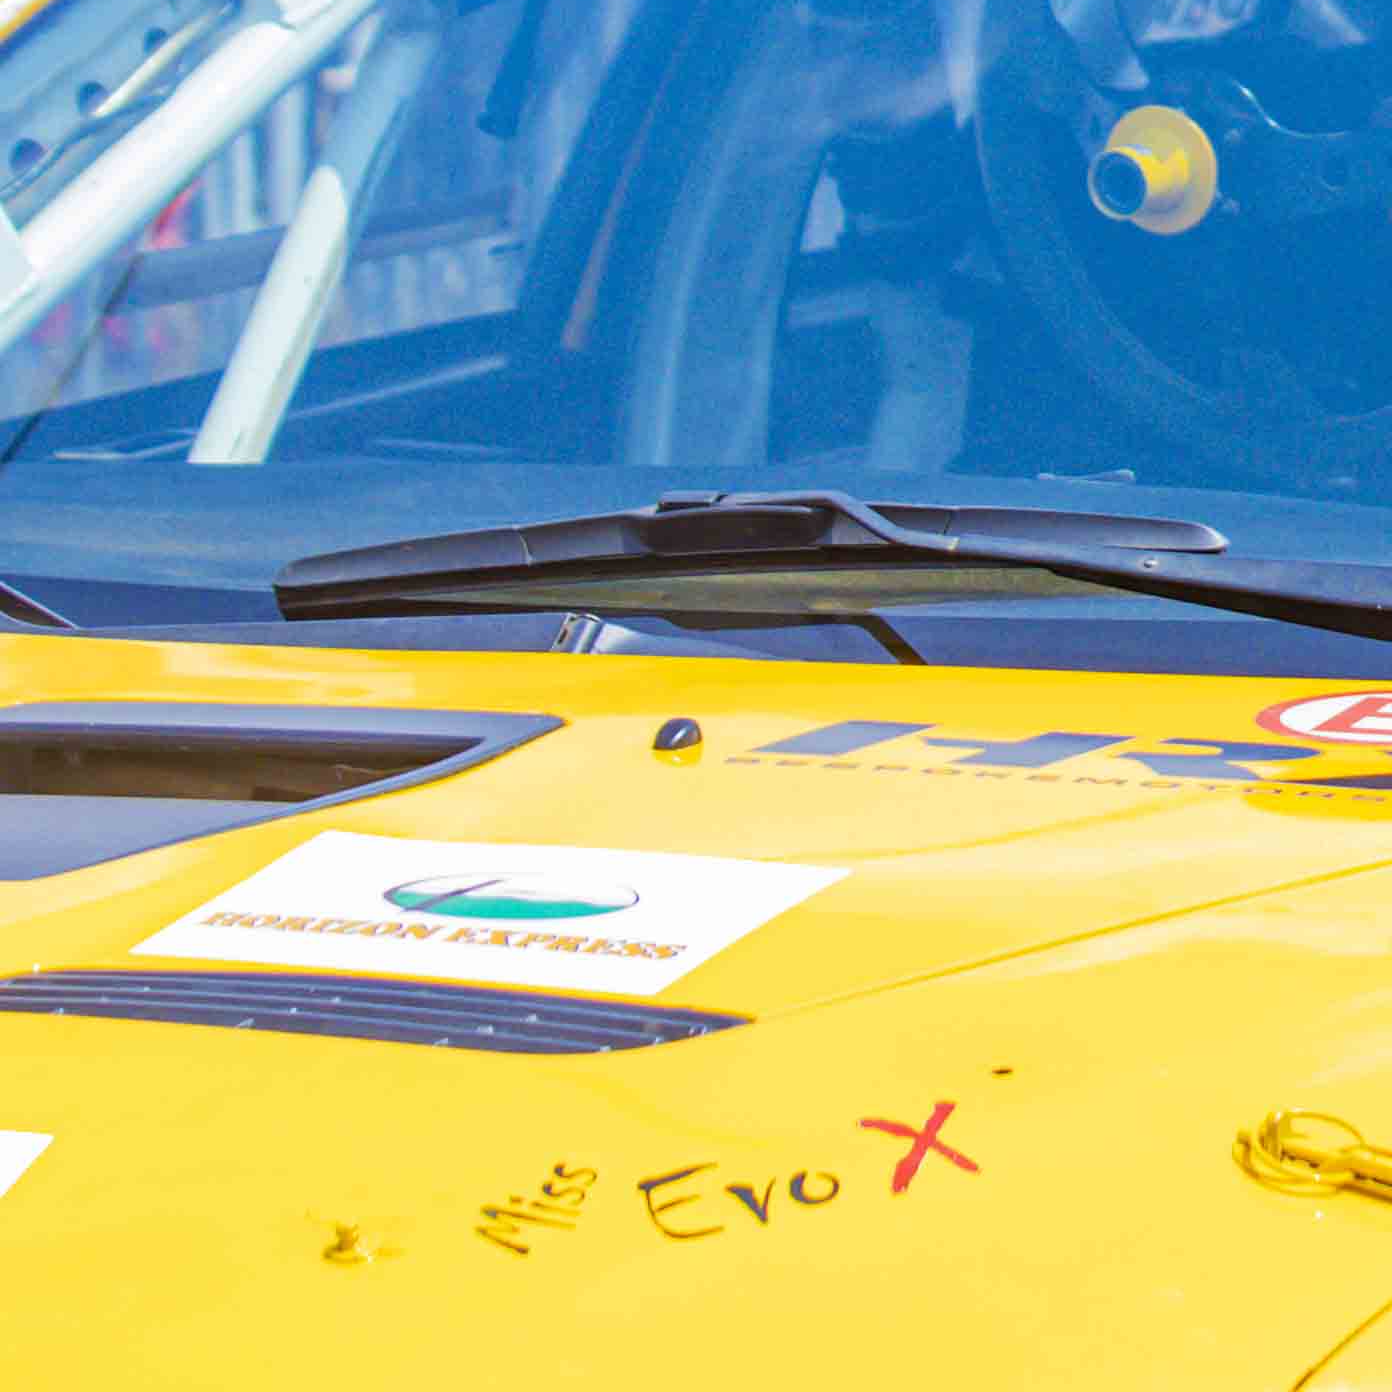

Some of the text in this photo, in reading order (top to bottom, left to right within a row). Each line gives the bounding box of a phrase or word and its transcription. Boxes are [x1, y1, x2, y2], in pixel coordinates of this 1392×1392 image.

[199, 910, 688, 960] HORIZON EXPRESS
[475, 1162, 598, 1255] Miss
[637, 1160, 840, 1240] Evo
